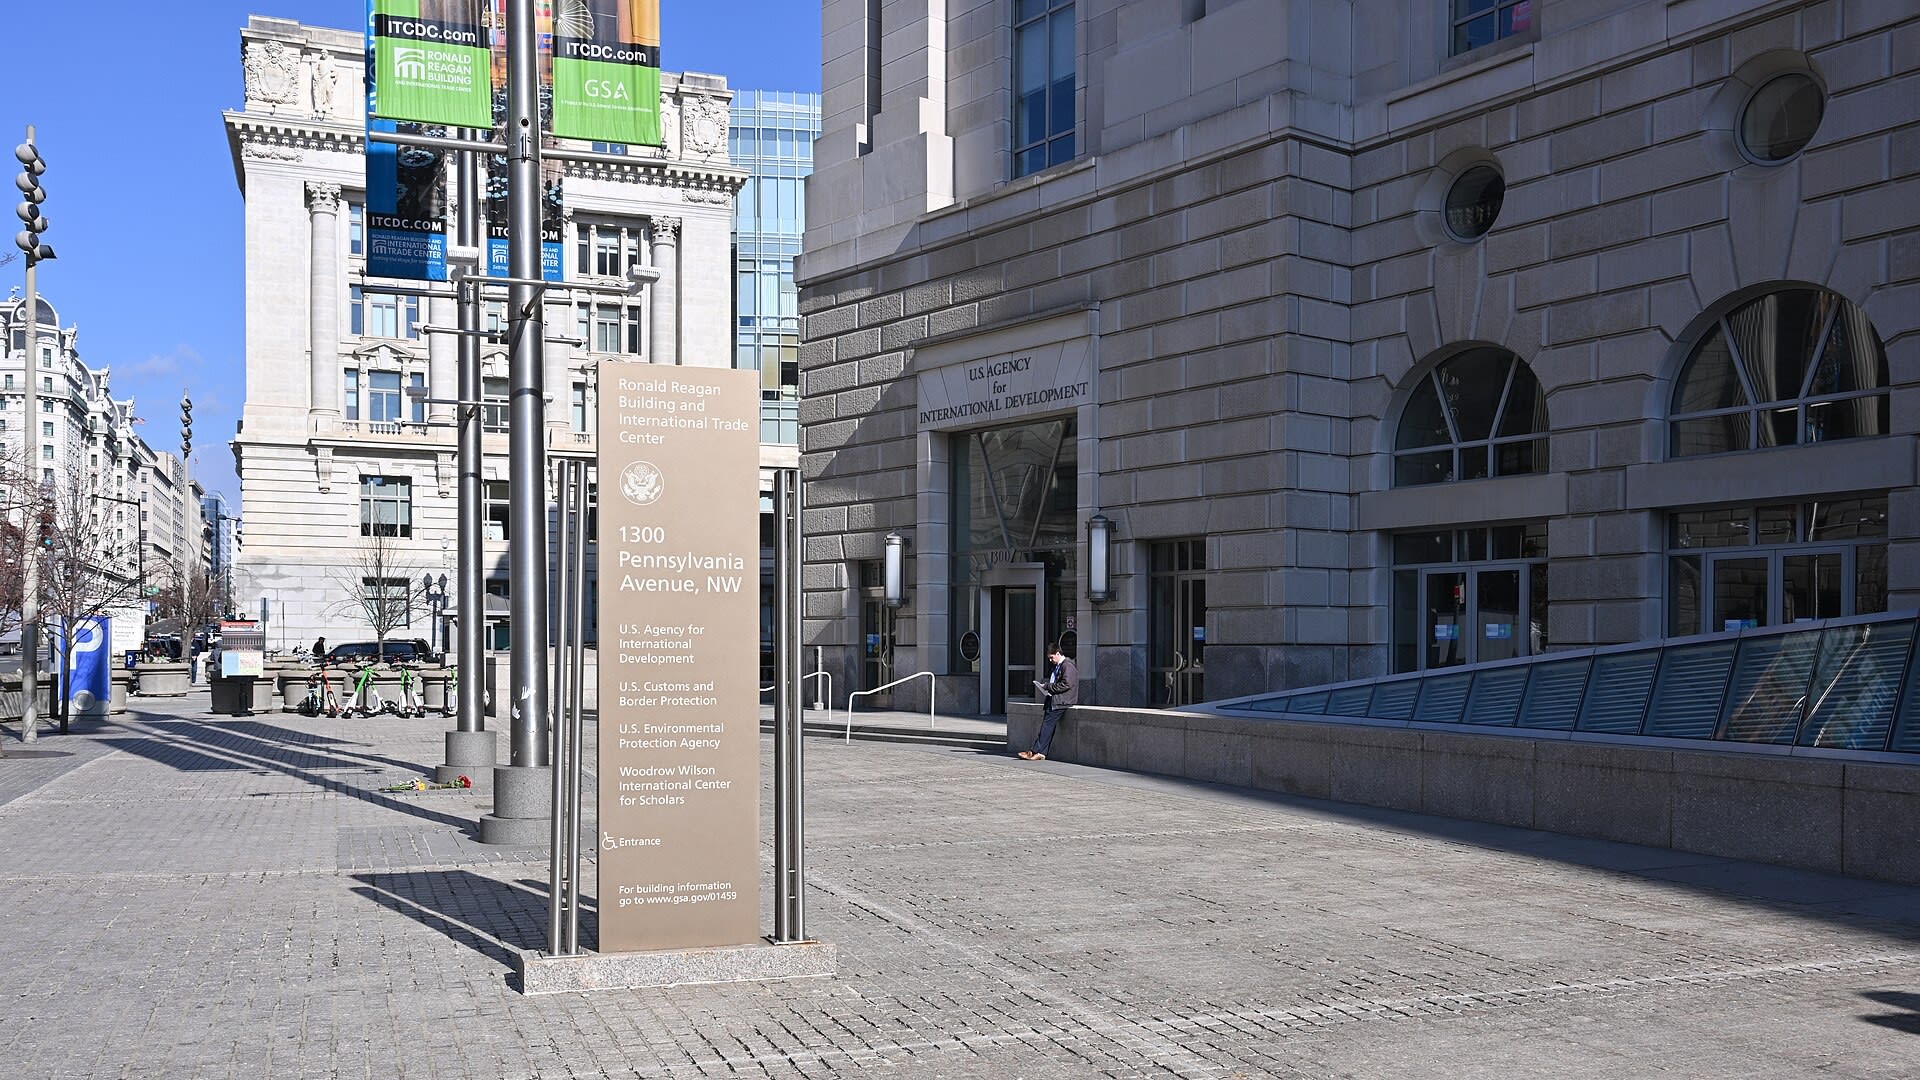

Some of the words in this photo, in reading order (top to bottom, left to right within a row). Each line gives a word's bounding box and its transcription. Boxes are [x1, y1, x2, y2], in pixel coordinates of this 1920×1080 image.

[387, 20, 476, 43] ITCDC.com
[428, 51, 472, 64] RONALD
[566, 41, 647, 62] ITCDC.com
[428, 62, 472, 75] REAGAN
[428, 72, 472, 85] BUILDING
[584, 79, 629, 100] GSA
[371, 215, 442, 232] ITCDC.COM
[387, 240, 442, 252] INTERNATIONAL
[387, 247, 413, 257] TRADE
[413, 249, 442, 259] CENTER
[986, 357, 1032, 378] AGENCY
[618, 378, 667, 393] Ronald
[671, 381, 721, 398] Reagan
[993, 381, 1007, 394] for
[618, 395, 676, 413] Building
[679, 400, 705, 412] and
[919, 400, 1002, 424] INTERNATIONAL
[1005, 382, 1089, 409] DEVELOPMENT
[619, 412, 707, 429] International
[711, 417, 749, 431] Trade
[619, 431, 665, 445] Center
[619, 526, 665, 544] 1300
[619, 551, 744, 573] Pennsylvania
[619, 574, 699, 595] Avenue,
[707, 576, 742, 593] NW
[619, 623, 641, 635] U.S.
[643, 624, 685, 637] Agency
[688, 624, 705, 635] for
[619, 638, 692, 649] International
[619, 653, 695, 665] Development
[619, 681, 641, 692] U.S.
[643, 681, 690, 692] Customs
[692, 680, 714, 691] and
[619, 696, 657, 707] Border
[660, 695, 717, 706] Protection
[619, 723, 641, 734] U.S.
[644, 722, 724, 734] Environmental
[619, 737, 677, 749] Protection
[679, 737, 721, 750] Agency
[619, 766, 676, 777] Woodrow
[678, 764, 716, 776] Wilson
[619, 779, 692, 791] International
[694, 779, 732, 790] Center
[619, 795, 636, 806] for
[639, 794, 685, 806] Scholars
[619, 837, 661, 847] Entrance
[619, 885, 634, 894] For
[636, 883, 675, 894] building
[677, 880, 732, 892] information
[619, 897, 632, 907] go
[634, 895, 644, 905] to
[646, 891, 737, 905] www.gsa.gov/01459
